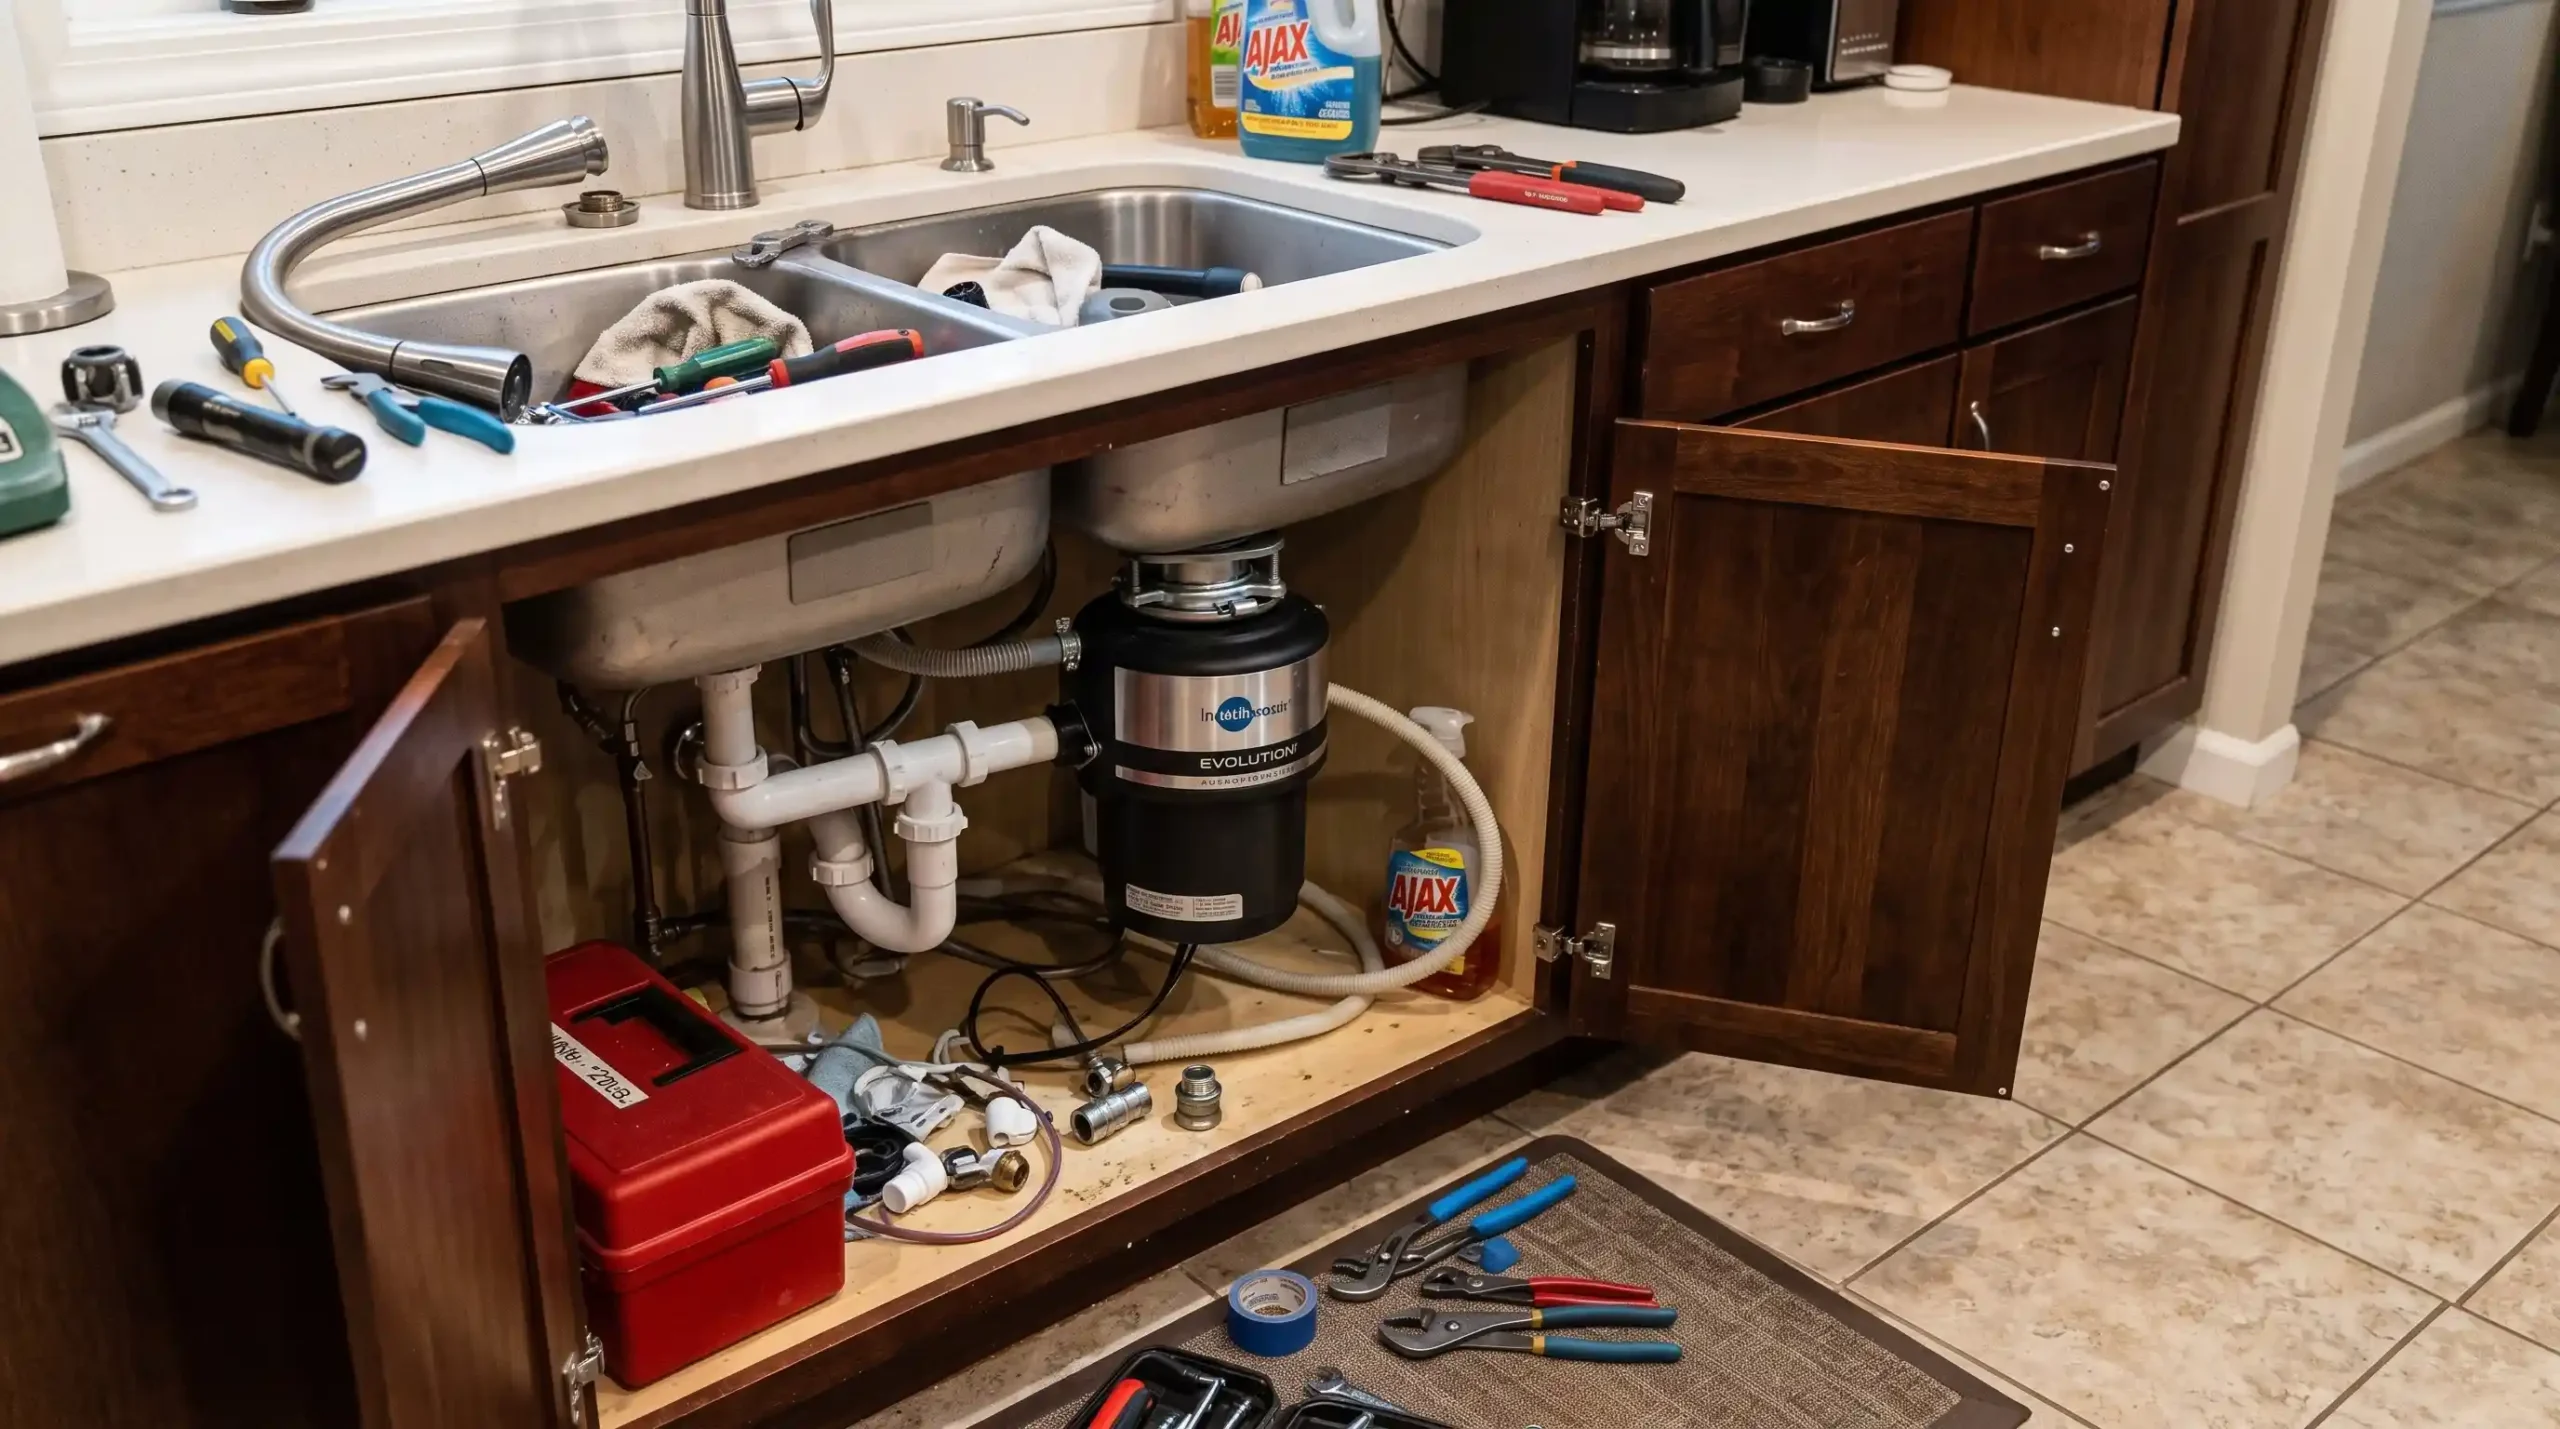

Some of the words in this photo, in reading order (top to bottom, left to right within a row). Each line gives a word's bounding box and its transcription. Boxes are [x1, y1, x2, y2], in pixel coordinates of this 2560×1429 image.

[1216, 12, 1242, 48] AJ
[1246, 21, 1309, 76] AJAX
[1390, 874, 1459, 920] AJAX
